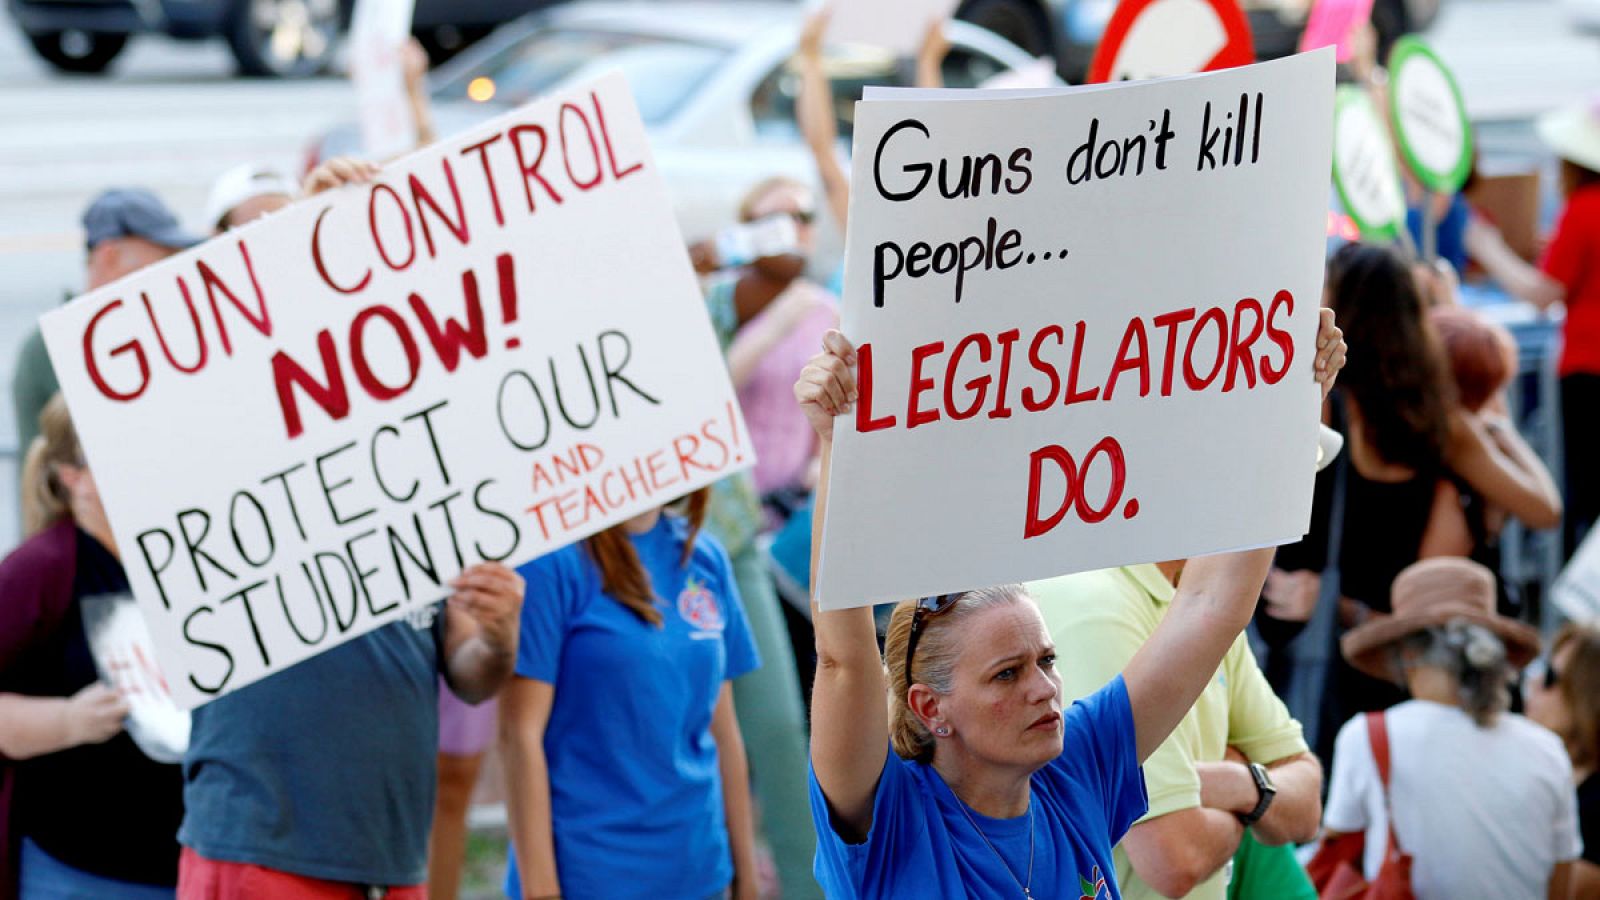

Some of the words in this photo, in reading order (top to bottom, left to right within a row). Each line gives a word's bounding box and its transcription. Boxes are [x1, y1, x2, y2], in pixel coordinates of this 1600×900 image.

[872, 118, 1033, 203] Guns
[1066, 108, 1176, 186] don't
[1196, 91, 1264, 172] kill
[82, 240, 273, 403] GUN
[311, 92, 642, 295] CONTROL
[872, 216, 1069, 309] people...
[270, 252, 519, 440] NOW!
[856, 289, 1296, 433] LEGISLATORS
[135, 400, 451, 611] PROTECT
[496, 330, 661, 452] OUR
[524, 400, 743, 541] TEACHERS!
[531, 443, 606, 493] AND
[1023, 435, 1140, 540] DO.
[182, 479, 521, 695] STUDENTS
